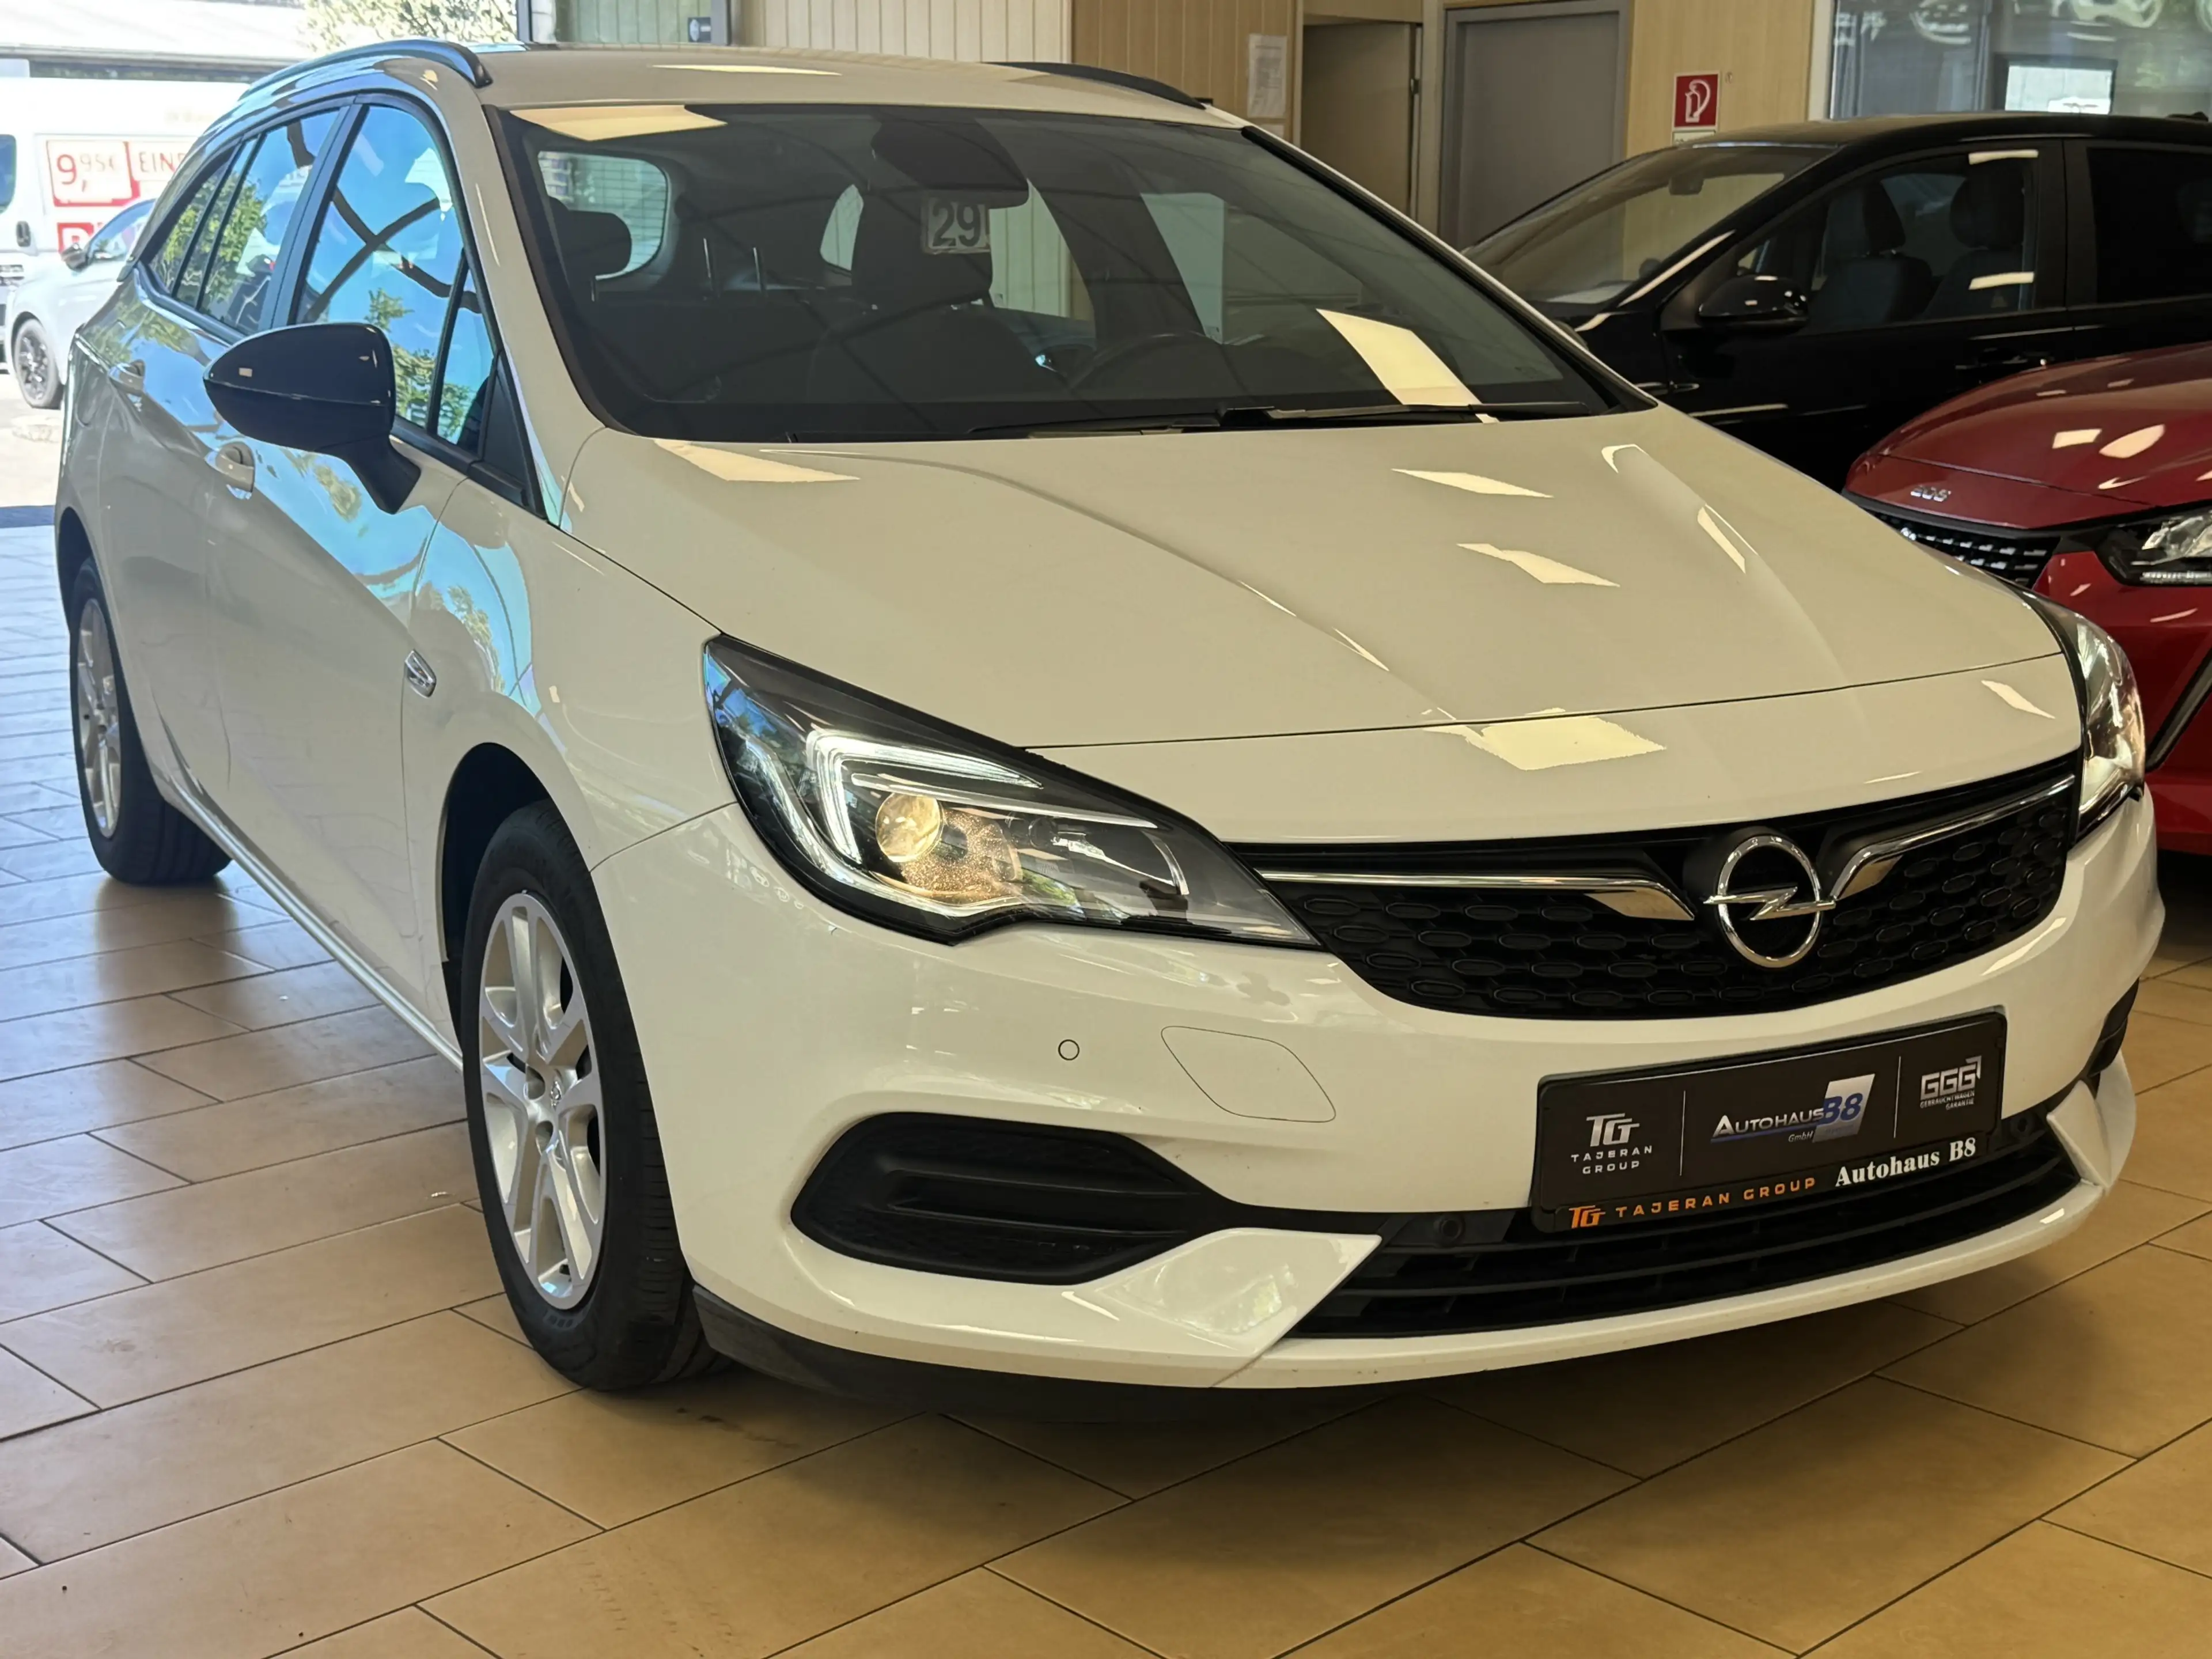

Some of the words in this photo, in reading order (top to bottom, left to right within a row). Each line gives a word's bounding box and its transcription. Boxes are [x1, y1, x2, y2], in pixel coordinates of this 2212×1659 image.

[932, 200, 981, 247] 29
[1788, 1130, 1813, 1143] GmbH
[1570, 1145, 1653, 1163] TAJERAN
[1582, 1161, 1641, 1175] GROUP
[1835, 1150, 1940, 1188] Autohaus
[1949, 1137, 1976, 1162] B8
[1615, 1192, 1730, 1218] TAJERAN
[1743, 1177, 1816, 1201] GROUP
